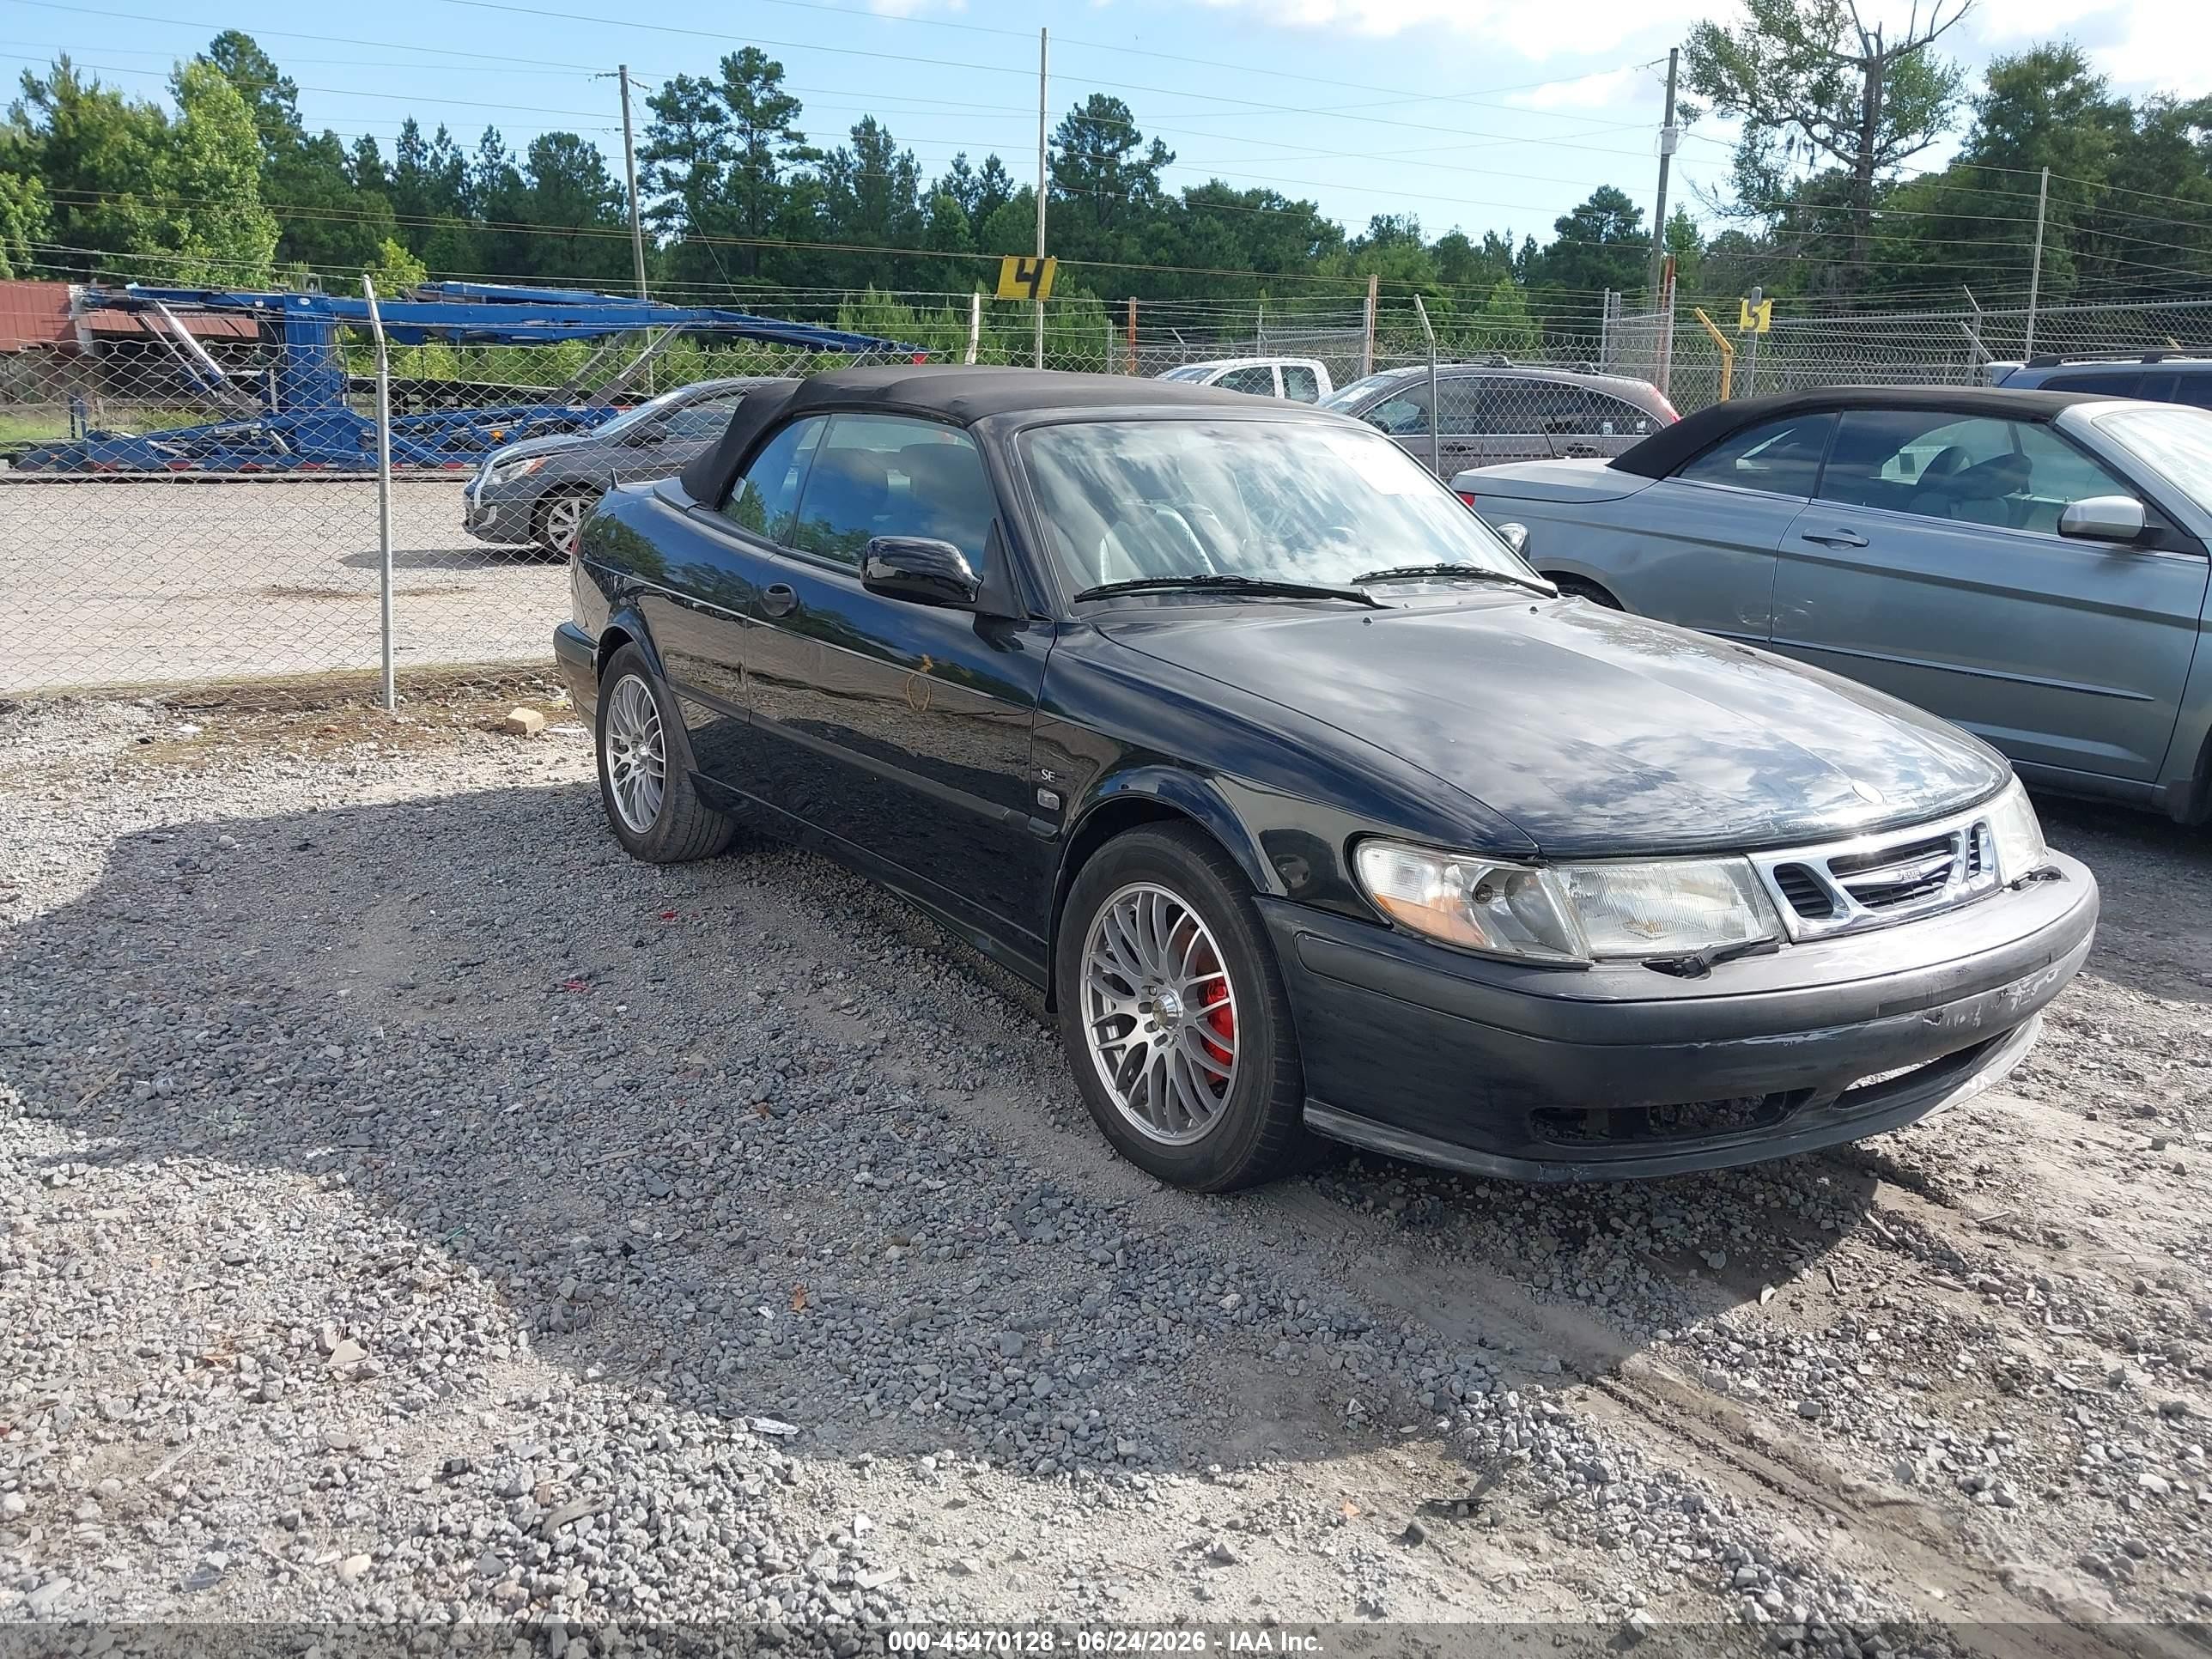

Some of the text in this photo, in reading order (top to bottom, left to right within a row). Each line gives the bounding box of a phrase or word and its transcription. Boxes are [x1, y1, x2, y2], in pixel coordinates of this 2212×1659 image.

[1016, 258, 1044, 299] 4
[1743, 299, 1764, 331] 5
[1041, 769, 1056, 783] SE
